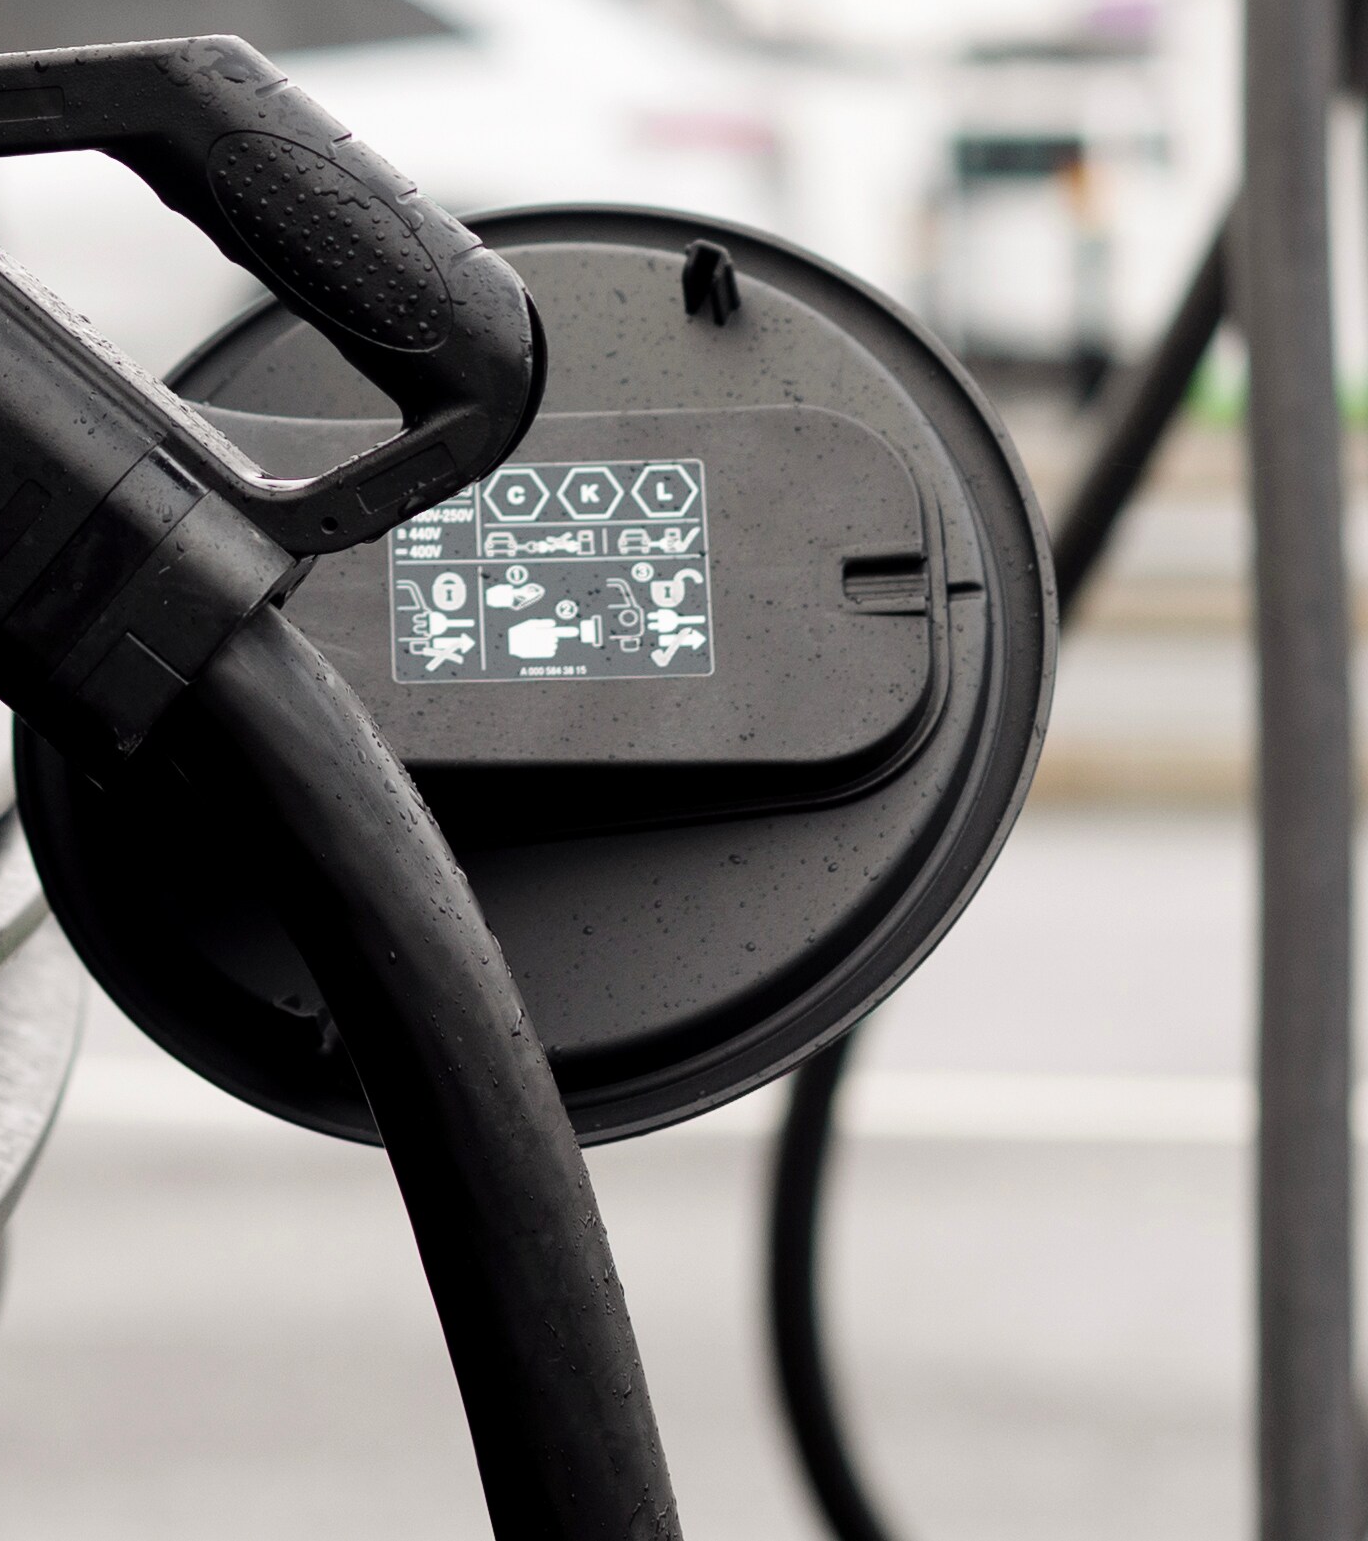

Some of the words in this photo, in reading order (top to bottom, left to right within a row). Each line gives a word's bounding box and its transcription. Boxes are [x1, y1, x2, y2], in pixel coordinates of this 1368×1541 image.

[506, 485, 526, 505] C
[579, 483, 601, 504] K
[655, 481, 674, 502] L
[411, 508, 475, 523] 00V-250V
[408, 526, 443, 541] 440V
[409, 544, 443, 559] 400V
[519, 666, 528, 676] A
[528, 666, 545, 676] 000
